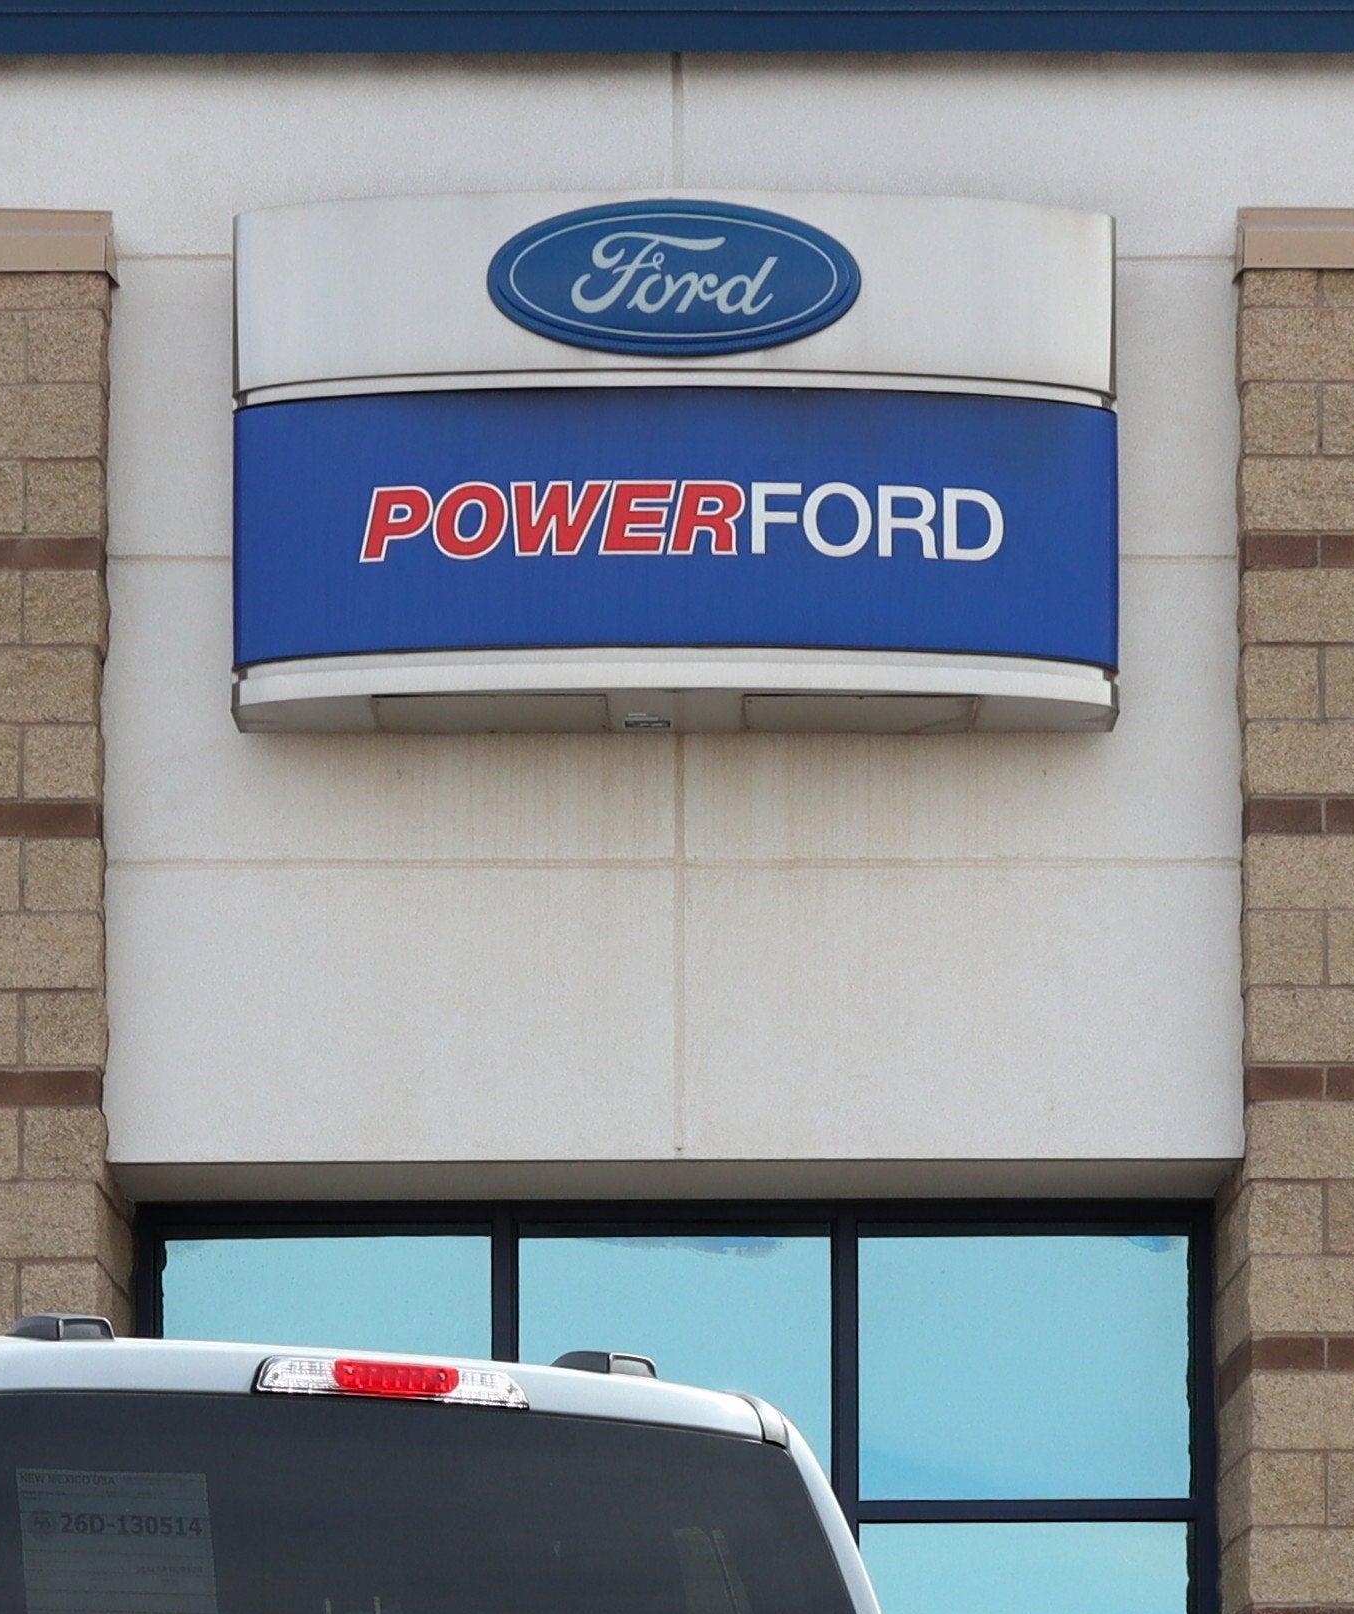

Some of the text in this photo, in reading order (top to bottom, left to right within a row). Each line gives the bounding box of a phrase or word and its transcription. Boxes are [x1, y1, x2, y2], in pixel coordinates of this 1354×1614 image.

[572, 230, 777, 315] Ford
[358, 479, 1005, 564] POWERFORD
[60, 1512, 203, 1536] 26D-130514
